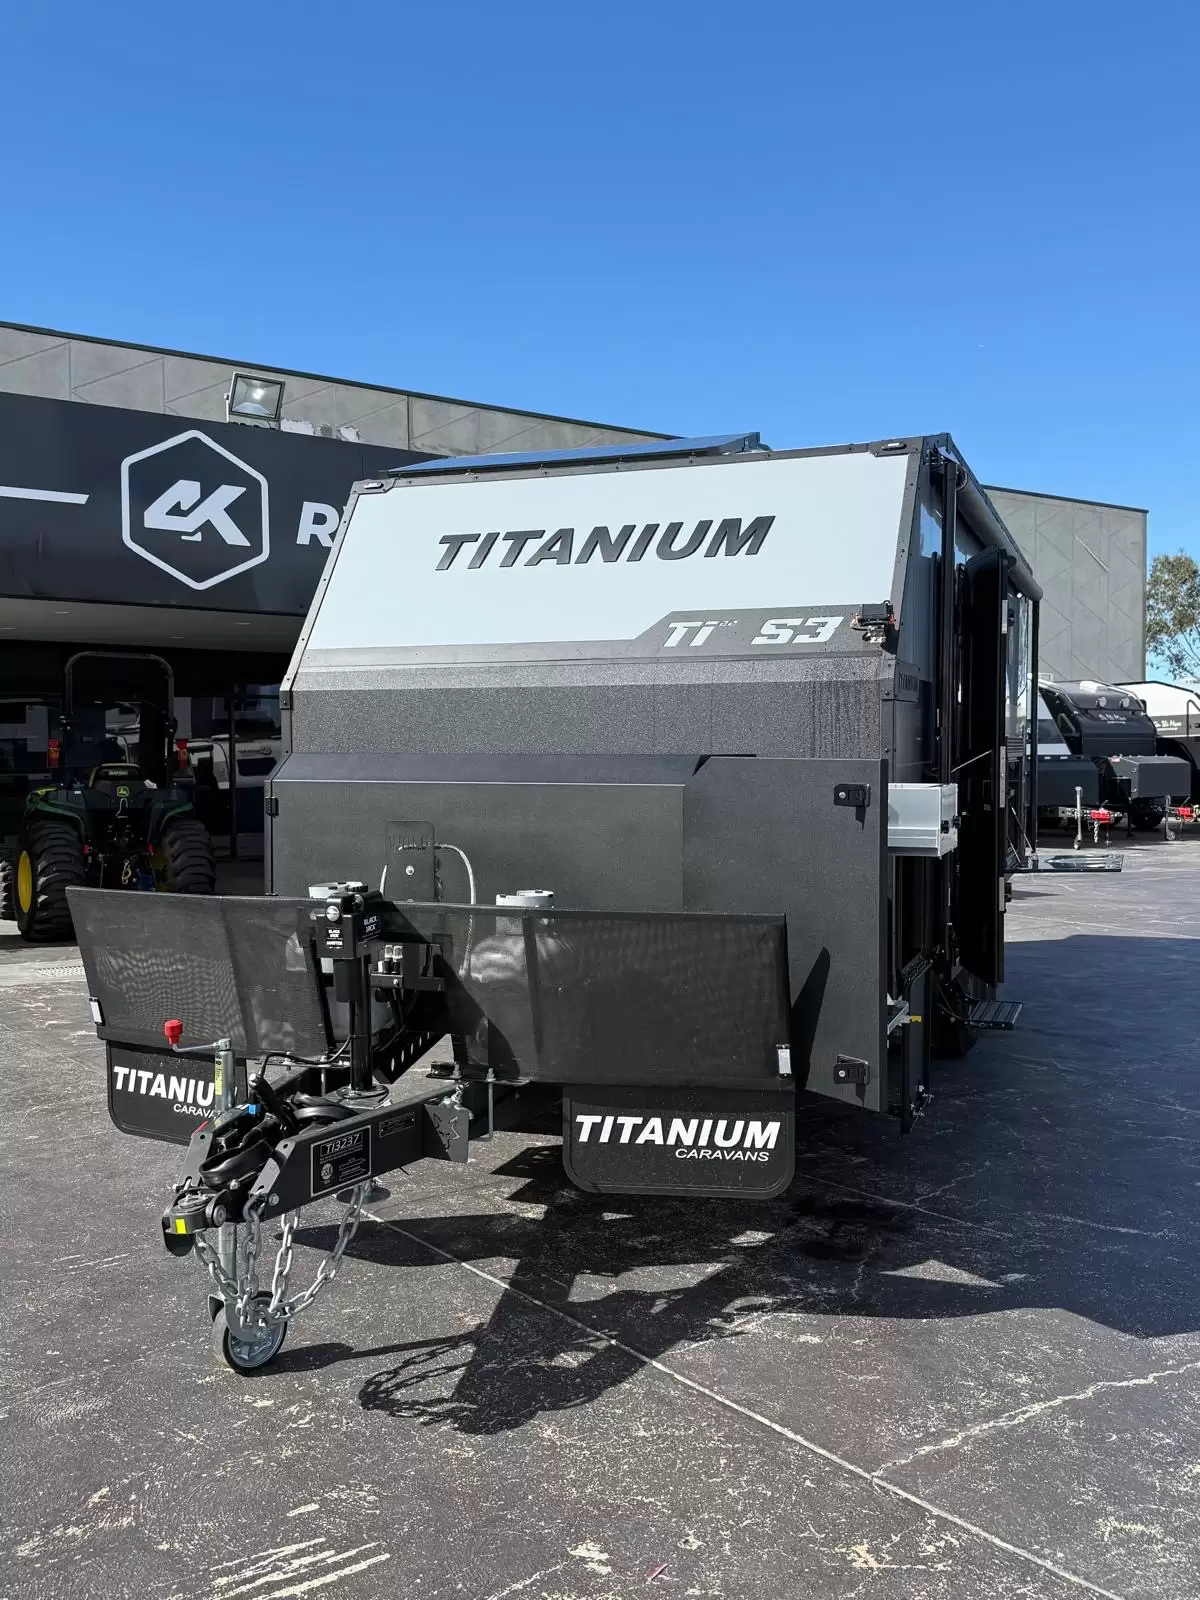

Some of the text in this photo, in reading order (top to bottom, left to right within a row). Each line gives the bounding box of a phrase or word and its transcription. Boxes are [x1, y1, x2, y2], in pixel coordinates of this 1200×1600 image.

[296, 501, 347, 548] R
[435, 515, 776, 571] TITANIUM
[750, 616, 845, 645] S3
[113, 1065, 237, 1107] TITANIU
[575, 1114, 781, 1150] TITANIUM
[675, 1148, 770, 1162] CARAVANS
